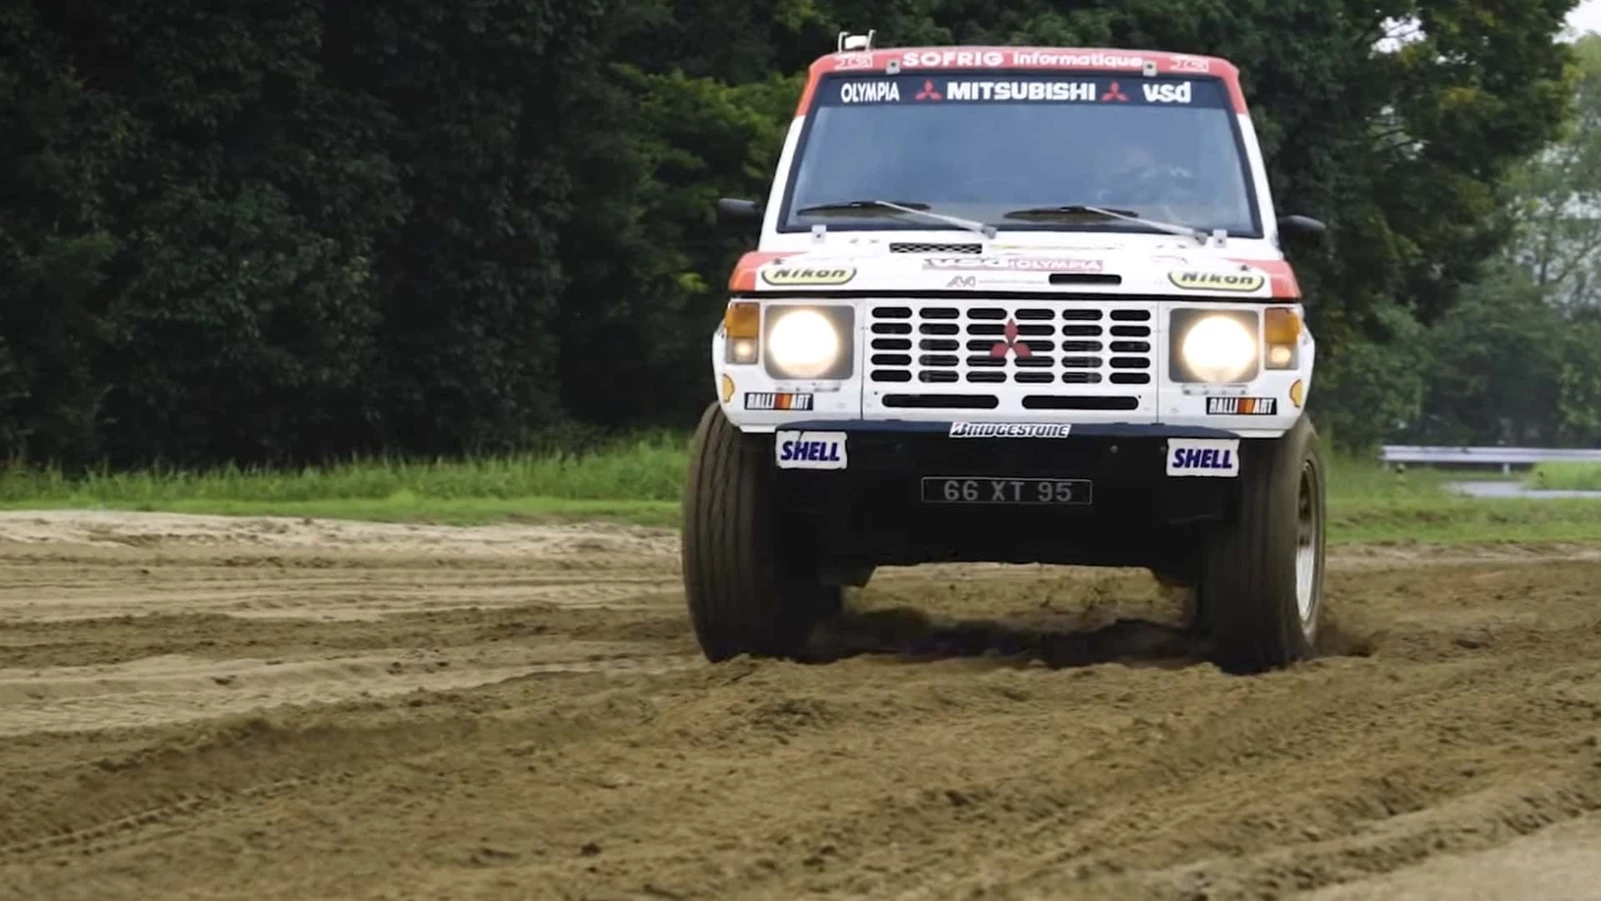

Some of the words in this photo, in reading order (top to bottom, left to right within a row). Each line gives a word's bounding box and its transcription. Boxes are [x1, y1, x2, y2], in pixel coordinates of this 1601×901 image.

[902, 52, 1004, 68] SOFRIG
[841, 82, 900, 103] OLYMPIA
[947, 81, 1096, 101] MITSUBISHI
[1142, 81, 1192, 104] vsd
[773, 268, 847, 279] Nikon
[1016, 259, 1102, 270] OLYMPIA
[1181, 272, 1254, 286] Nikon
[951, 422, 1070, 437] BRIDGESTONE
[780, 440, 841, 462] SHELL
[1172, 448, 1233, 469] SHELL
[943, 480, 979, 501] 66
[991, 481, 1025, 501] XT
[1037, 482, 1073, 502] 95
